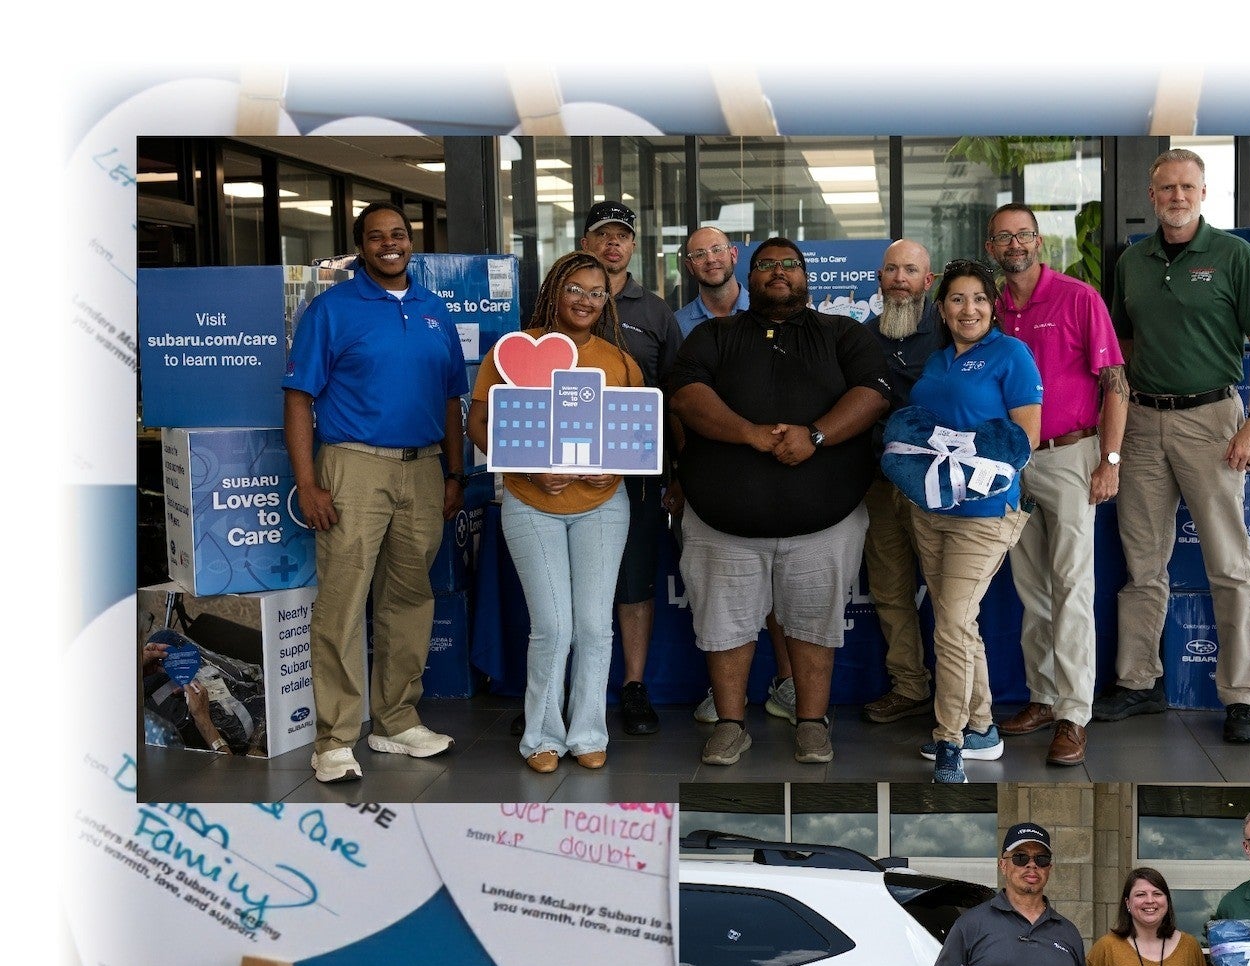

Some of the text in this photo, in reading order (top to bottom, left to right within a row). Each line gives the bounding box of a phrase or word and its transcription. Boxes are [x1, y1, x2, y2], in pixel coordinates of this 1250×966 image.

[820, 271, 875, 282] OF HOPE
[463, 300, 510, 312] to Care
[196, 313, 226, 326] Visit
[148, 328, 277, 348] subaru.com/care
[164, 354, 262, 366] to learn more.
[222, 475, 278, 489] SUBARU
[213, 491, 280, 510] Loves
[258, 510, 280, 526] to
[228, 527, 281, 546] Care
[278, 605, 308, 622] Nearly
[288, 720, 314, 734] SUBARU
[124, 839, 232, 910] McLarty Subaru is
[154, 874, 208, 913] love, and
[481, 883, 662, 929] Landers McLarty Subaru is
[493, 902, 640, 938] you warmth, love, and
